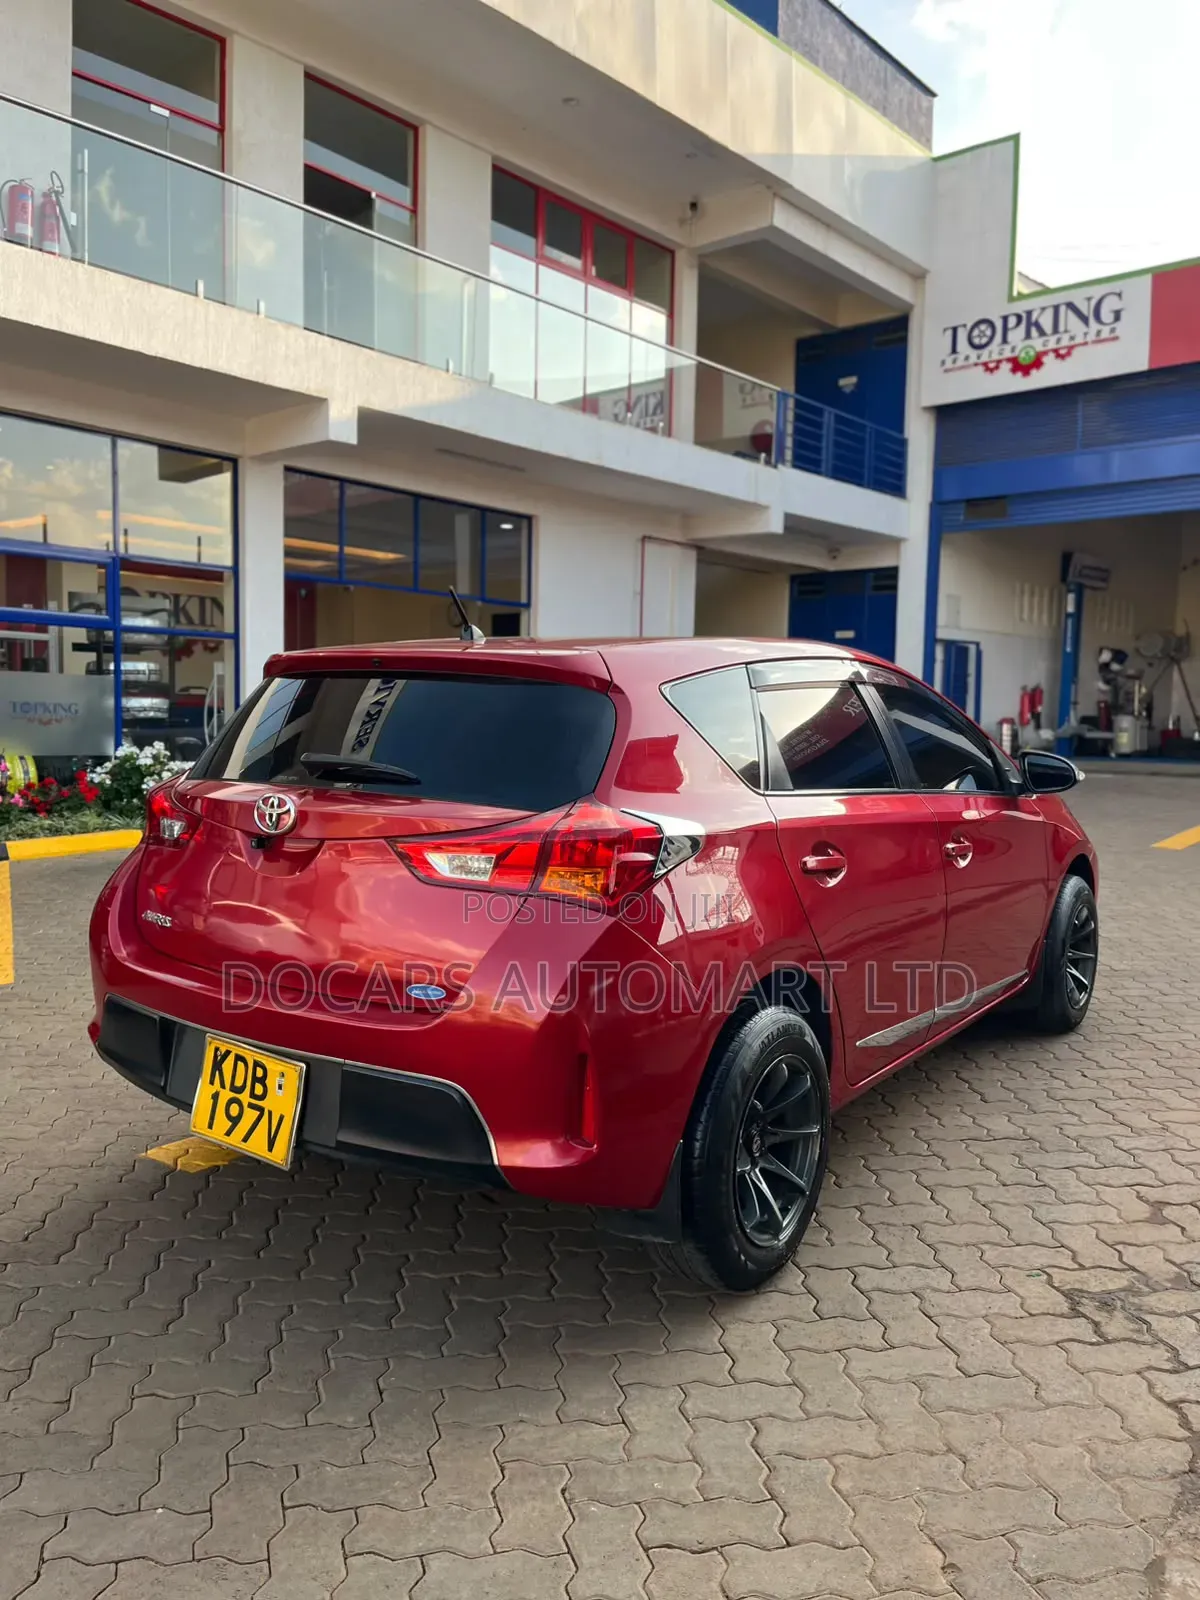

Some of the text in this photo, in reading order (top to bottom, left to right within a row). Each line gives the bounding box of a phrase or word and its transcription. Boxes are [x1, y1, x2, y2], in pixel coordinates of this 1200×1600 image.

[943, 290, 1125, 357] TOPKING
[208, 1046, 269, 1102] KDB
[207, 1089, 285, 1154] 197V
